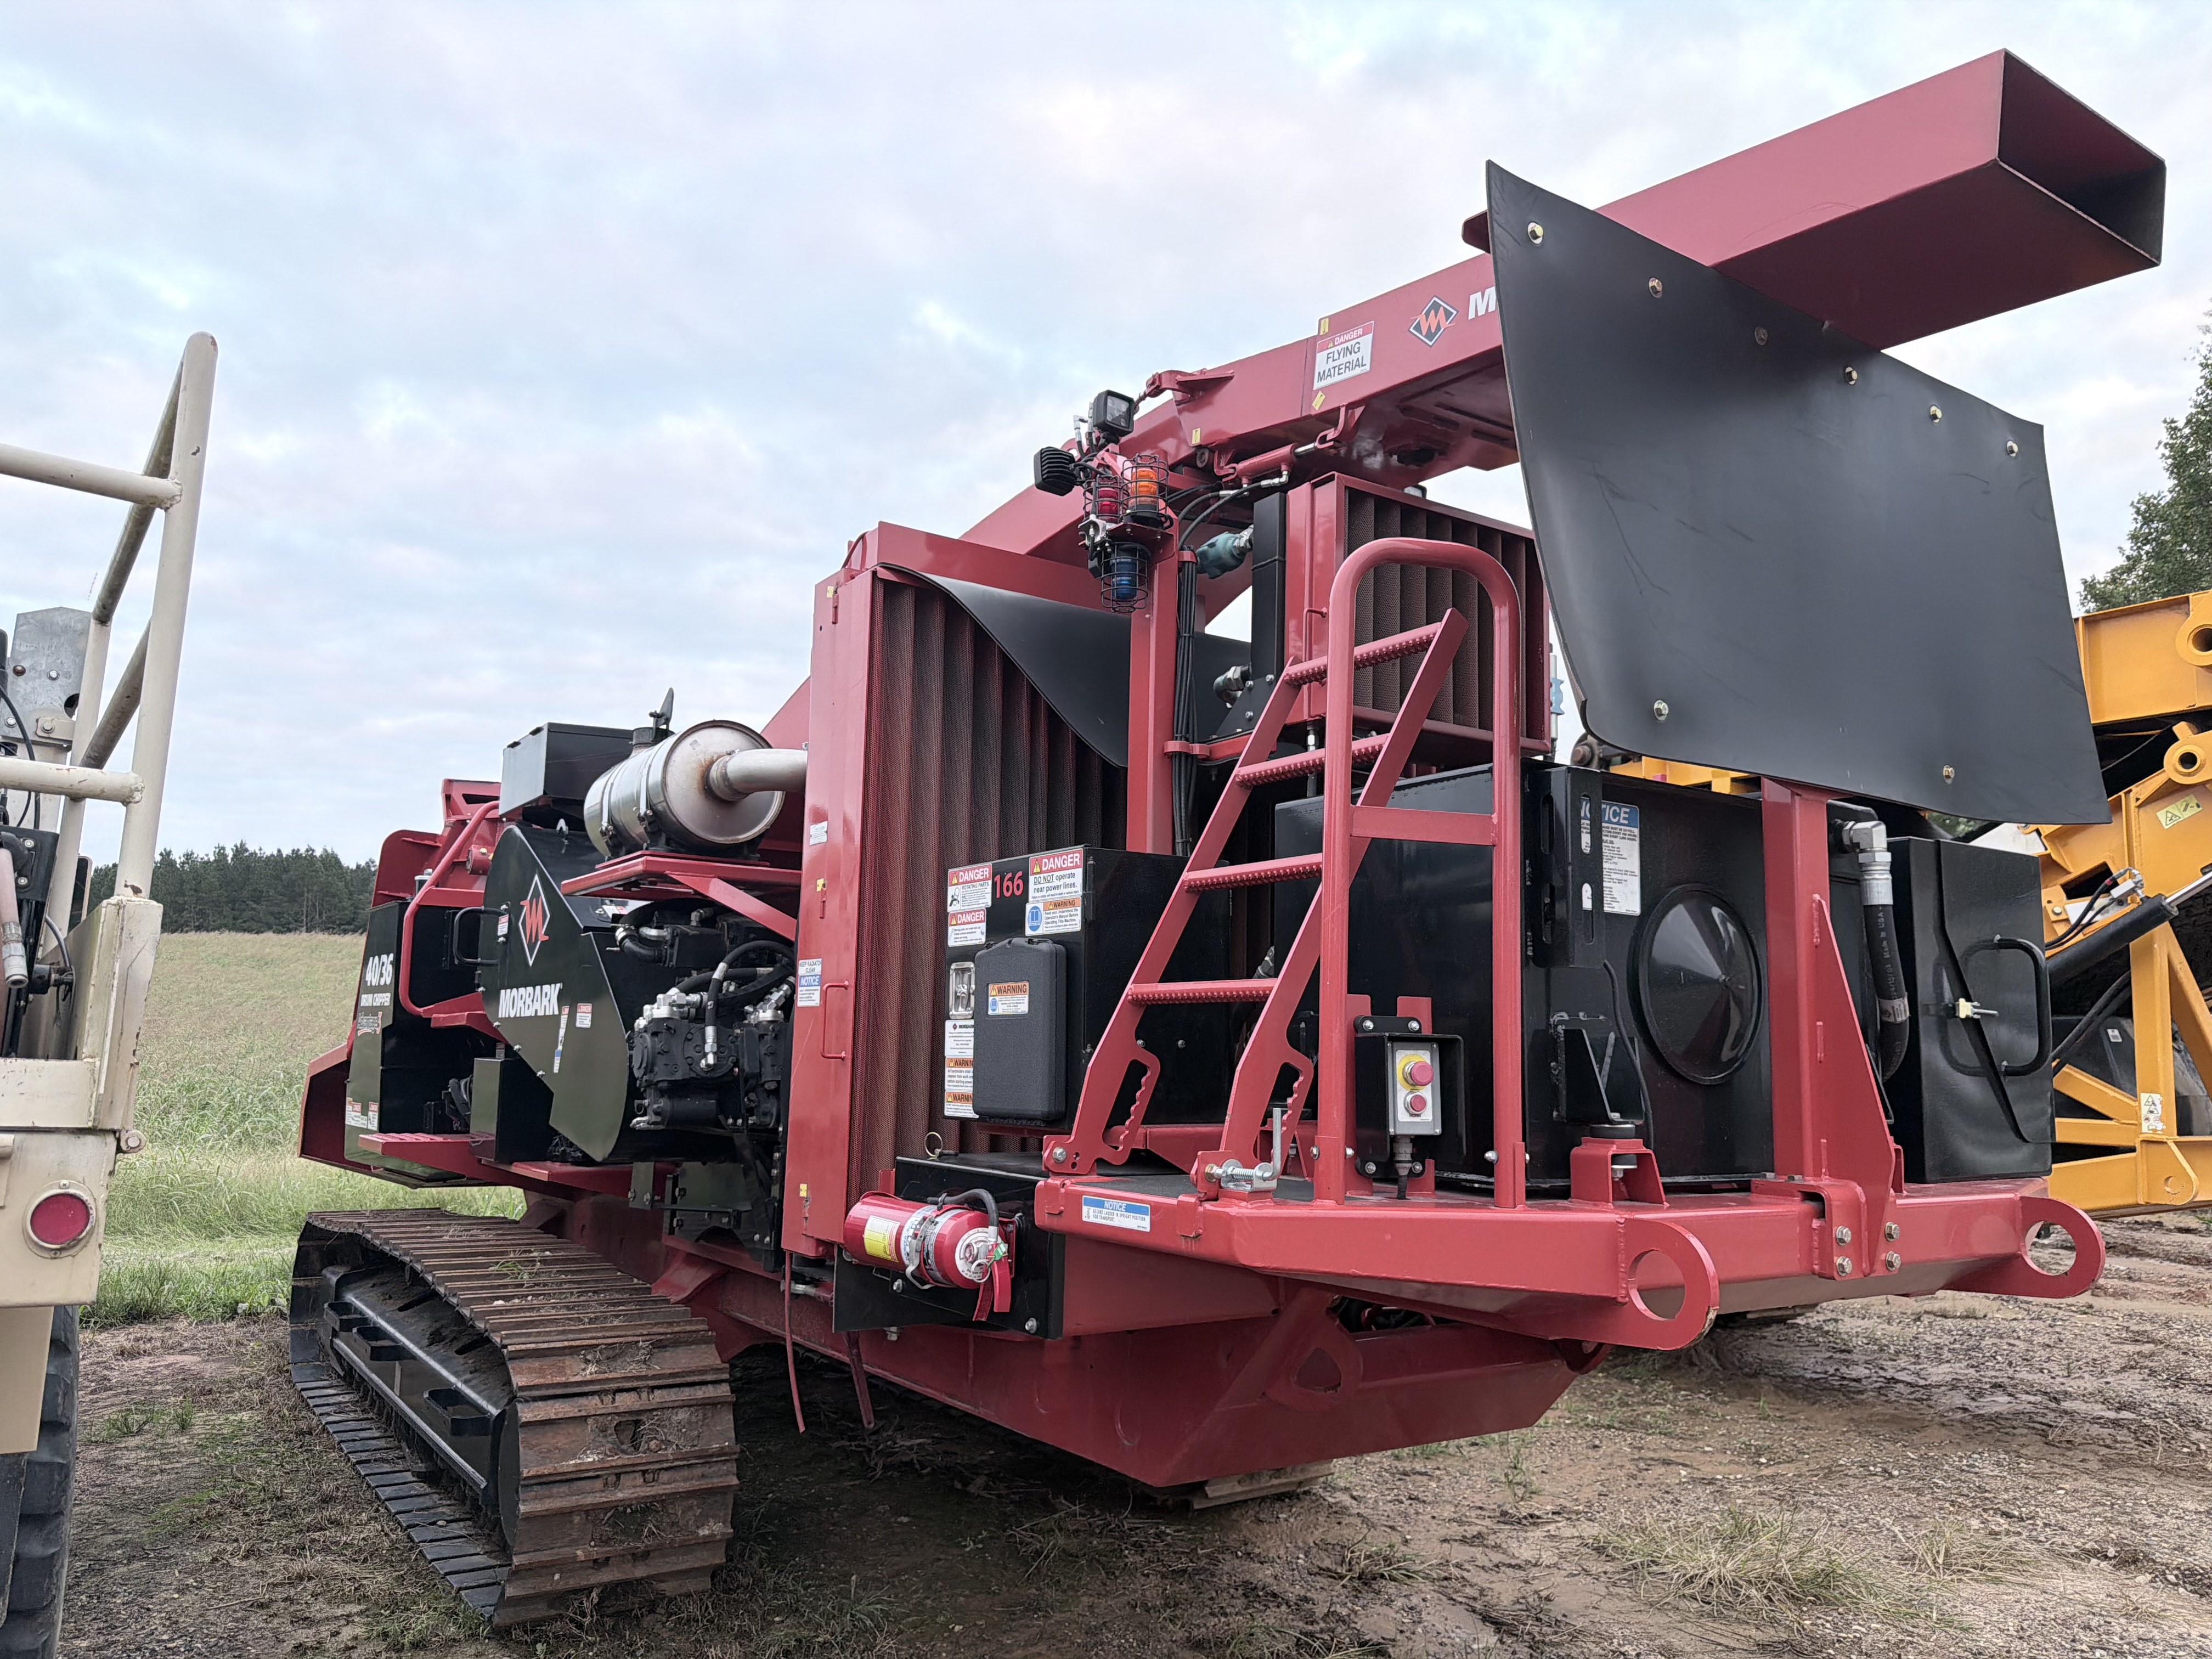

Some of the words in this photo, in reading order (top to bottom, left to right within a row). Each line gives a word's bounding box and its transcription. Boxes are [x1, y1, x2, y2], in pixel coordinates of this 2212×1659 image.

[1334, 328, 1363, 345] DANGER
[1326, 341, 1361, 364] FLYING
[1317, 356, 1367, 383] MATERIAL
[1042, 853, 1080, 871] DANGER
[959, 867, 989, 883] DANGER
[1034, 876, 1042, 884] DO
[1043, 874, 1054, 883] NOT
[1056, 872, 1075, 882] operate
[994, 871, 1024, 899] 166
[1046, 884, 1062, 893] power
[1053, 900, 1075, 908] WARNING
[957, 911, 984, 923] DANGER
[365, 953, 394, 986] 40/36
[800, 976, 820, 986] NOTICE
[997, 984, 1027, 995] WARNING
[498, 983, 561, 1018] MORBARK
[1104, 1200, 1126, 1211] NOTICE
